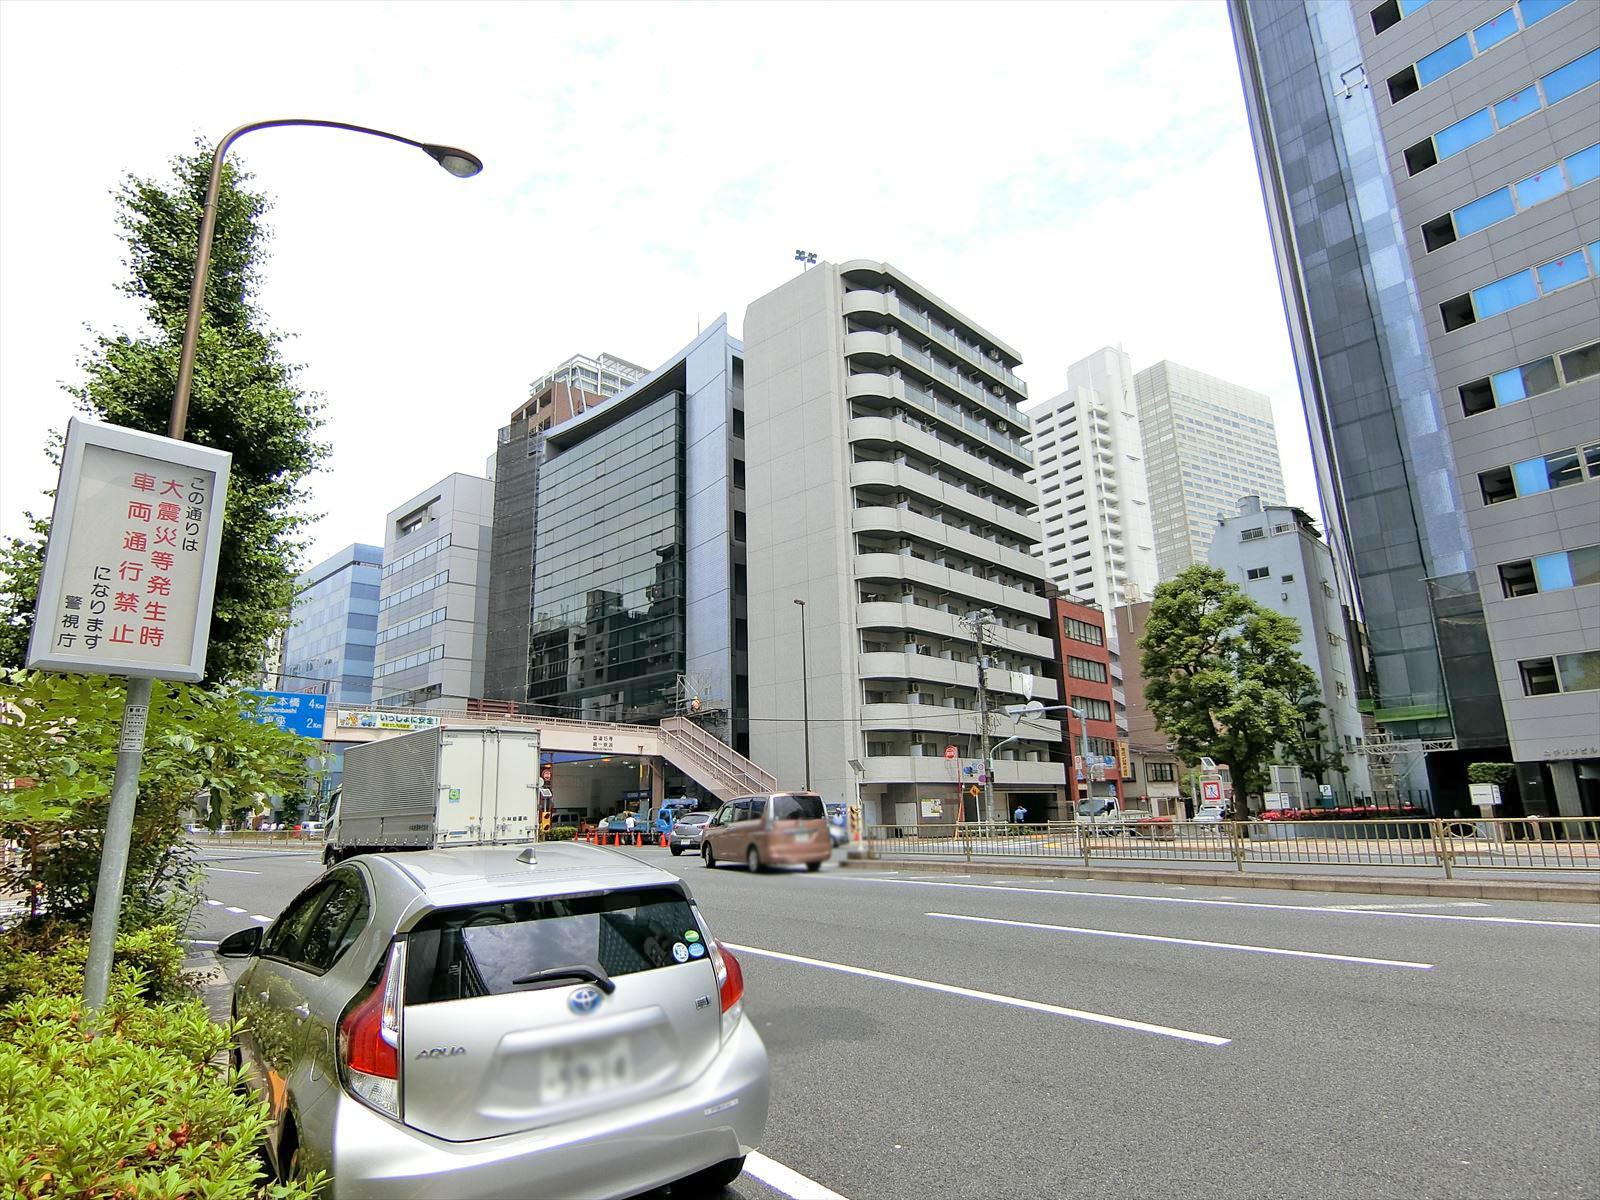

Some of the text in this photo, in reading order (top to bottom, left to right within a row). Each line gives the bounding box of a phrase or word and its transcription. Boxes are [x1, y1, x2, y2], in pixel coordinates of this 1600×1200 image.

[181, 476, 206, 552] この通りは
[109, 472, 156, 645] 車両通行禁止
[139, 479, 184, 647] 大震災等発生時
[57, 595, 83, 648] 警視庁
[84, 566, 111, 650] になります
[415, 1046, 467, 1060] AQUA
